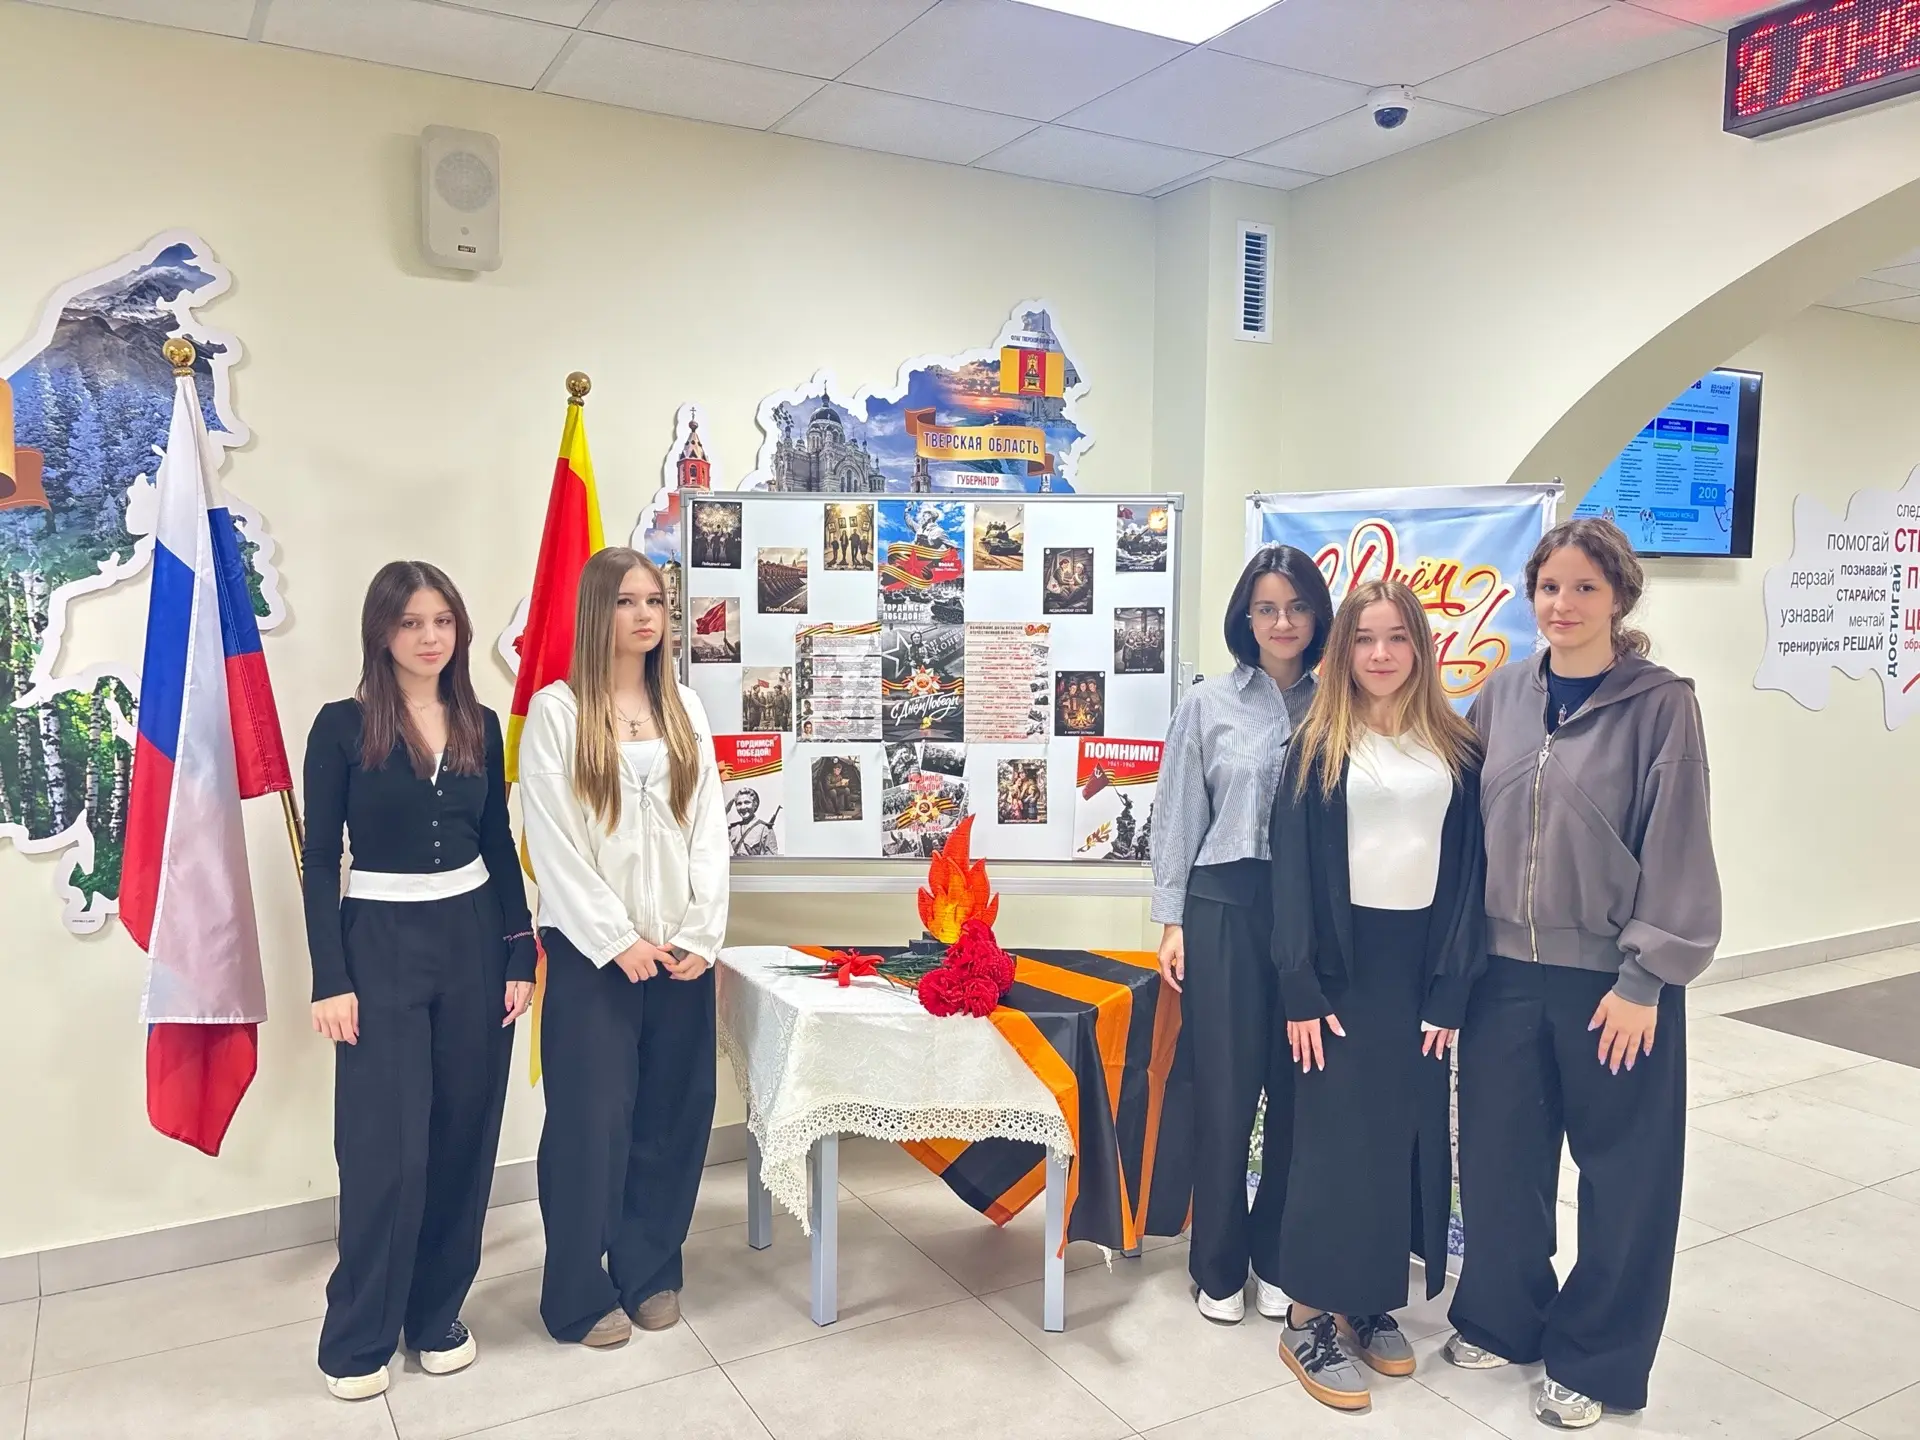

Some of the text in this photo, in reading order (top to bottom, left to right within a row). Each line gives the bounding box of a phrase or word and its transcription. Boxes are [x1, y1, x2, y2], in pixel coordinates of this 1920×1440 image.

[924, 432, 1040, 455] ТВЕРСКАЯ ОБЛАСТЬ
[957, 474, 1000, 487] ГУБЕРНАТОР
[1698, 486, 1718, 500] 200
[1827, 532, 1890, 552] помогай
[1841, 563, 1888, 577] познавай
[1791, 570, 1835, 589] дерзай
[1836, 586, 1887, 602] СТАРАЙСЯ
[882, 604, 926, 612] ГОРДИМСЯ
[882, 612, 921, 621] ПОБЕДОЙ!
[1780, 605, 1835, 628] узнавай
[1849, 613, 1885, 628] мечтай
[1887, 564, 1903, 678] достигай
[1778, 632, 1884, 656] тренируйся РЕШАЙ
[890, 692, 960, 726] С Днём Победы
[736, 738, 775, 748] ГОРДИМСЯ
[736, 748, 772, 757] ПОБЕДОЙ!
[1084, 742, 1160, 762] ПОМНИМ!
